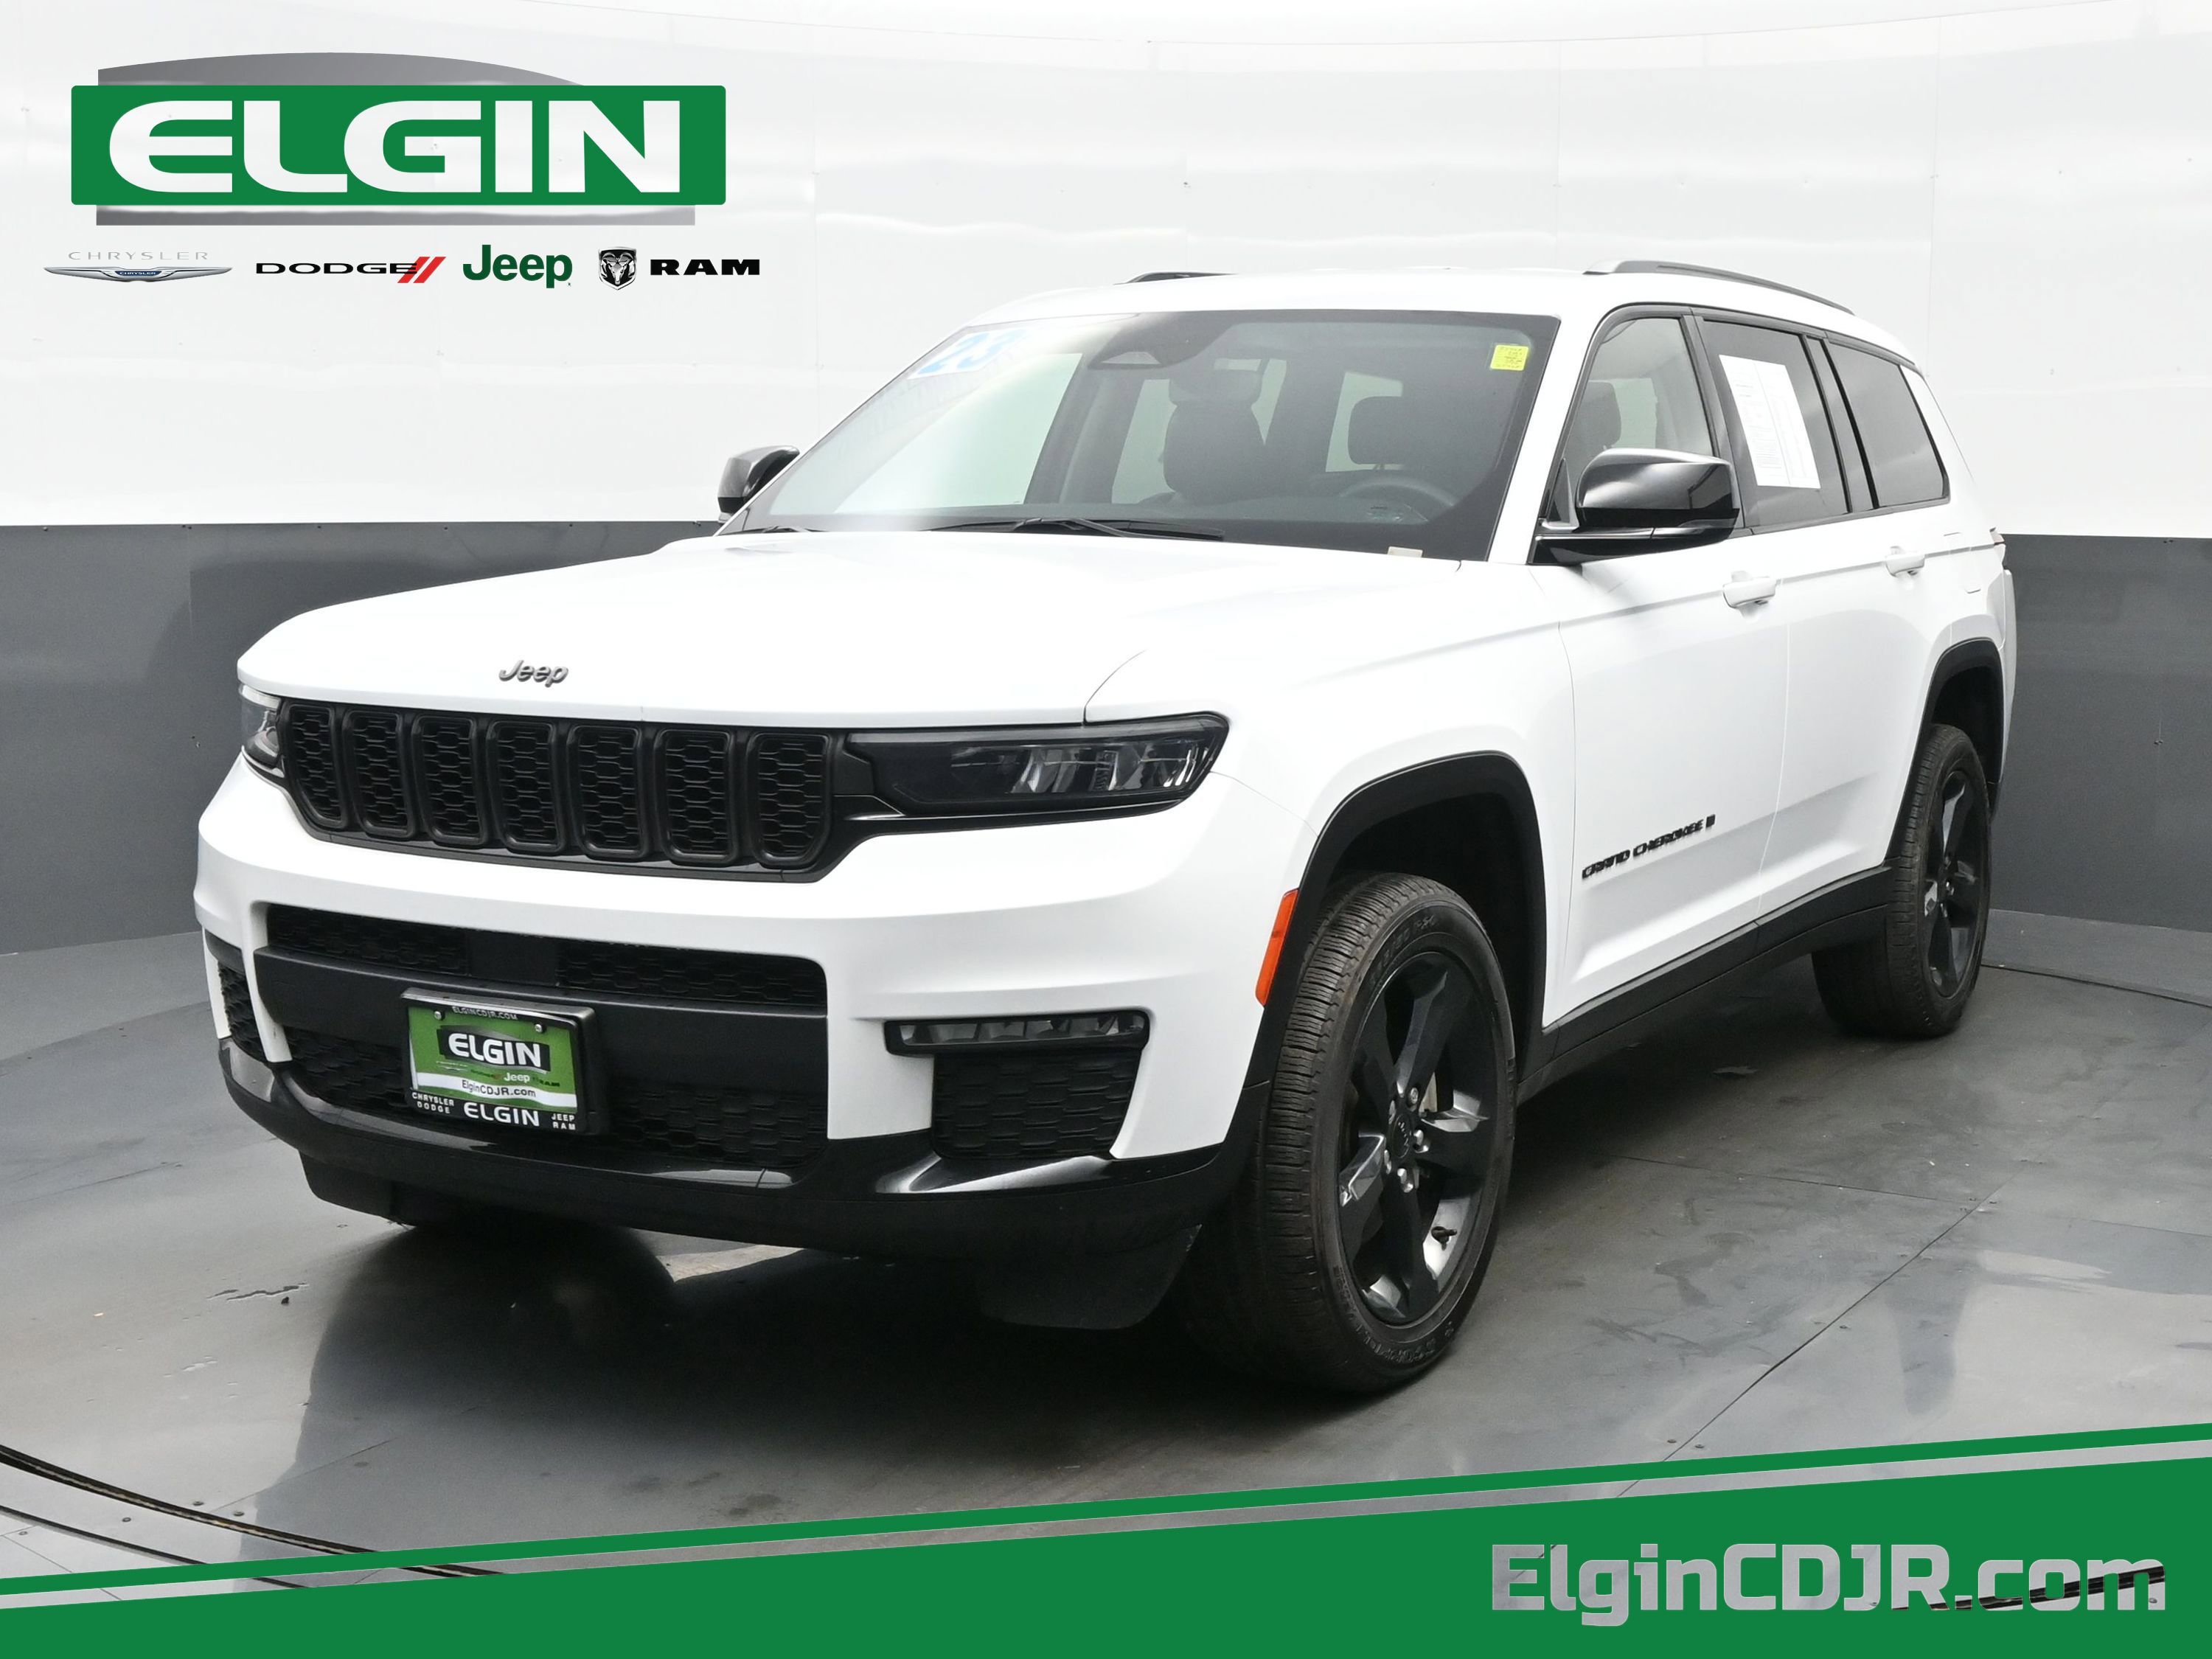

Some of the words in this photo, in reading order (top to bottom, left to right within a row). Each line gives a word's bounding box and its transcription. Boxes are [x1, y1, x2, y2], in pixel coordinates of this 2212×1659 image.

[498, 659, 569, 688] Jeep
[451, 1006, 518, 1020] ELGINCDJR.COM
[448, 1033, 541, 1067] ELGIN
[504, 1072, 530, 1083] Jeep
[462, 1079, 536, 1097] ElginCDJR.com
[411, 1091, 454, 1107] CHRYSLER
[417, 1100, 451, 1114] DODGE
[464, 1102, 540, 1127] ELGIN
[551, 1113, 575, 1121] JEEP
[552, 1121, 576, 1130] RAM
